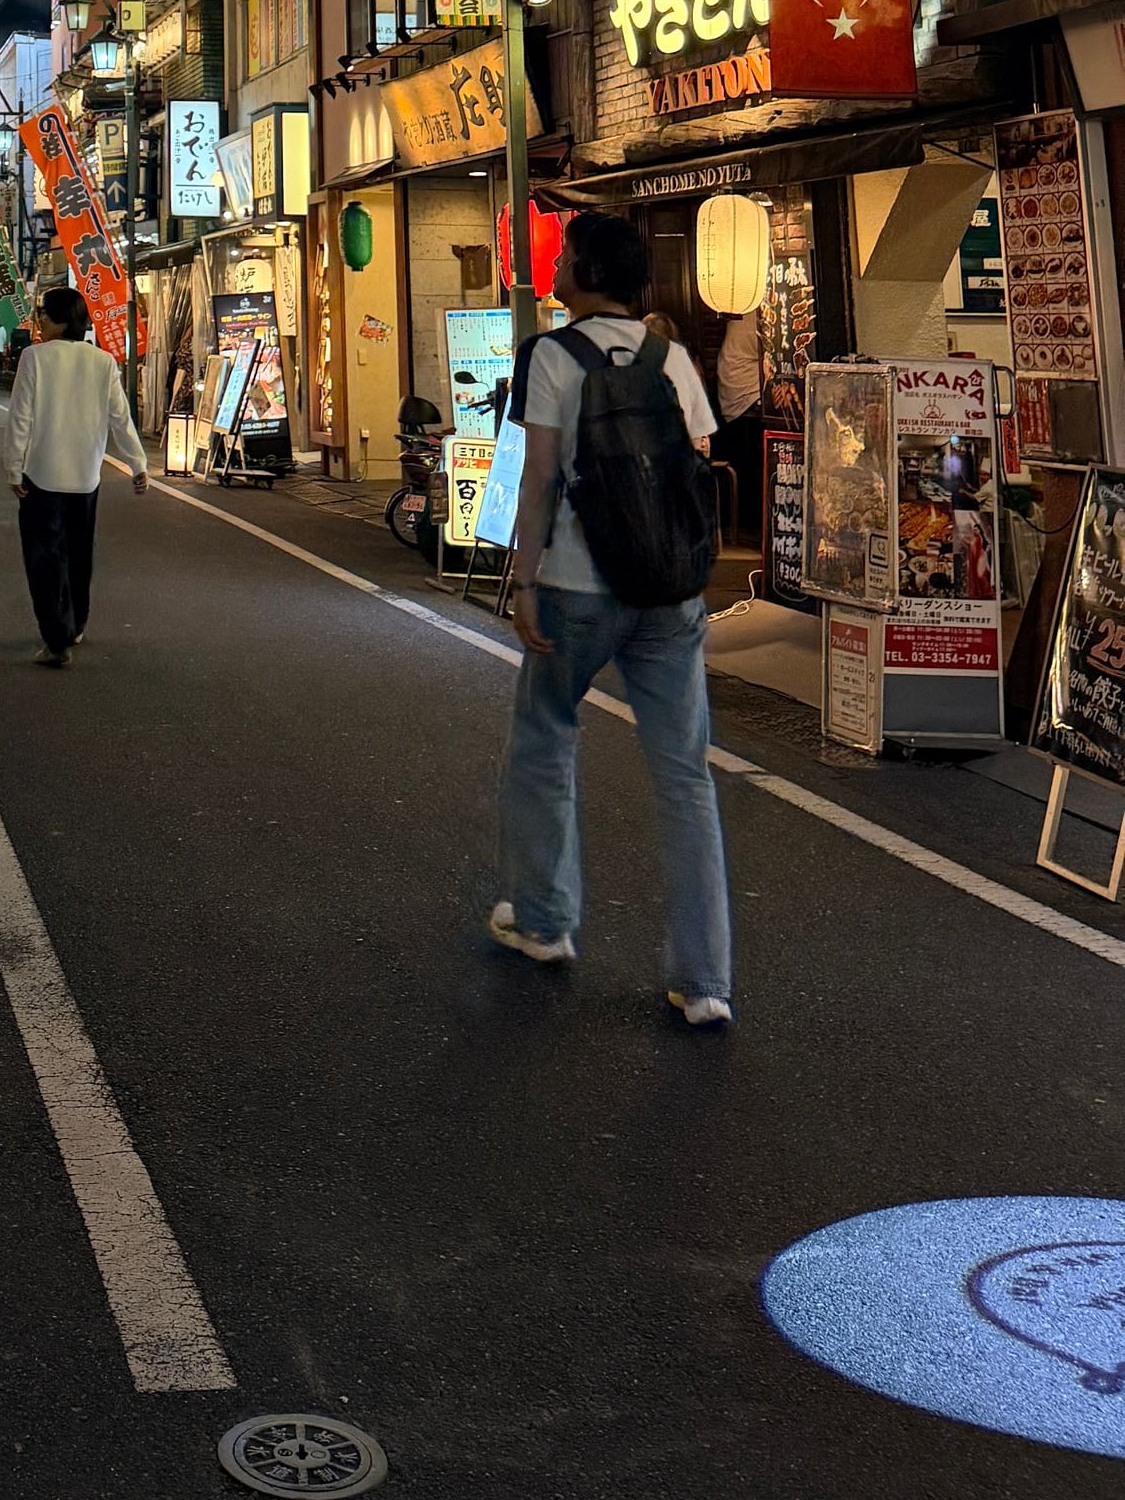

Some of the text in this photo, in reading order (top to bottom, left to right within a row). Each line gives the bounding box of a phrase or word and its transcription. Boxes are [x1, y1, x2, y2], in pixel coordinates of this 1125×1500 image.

[642, 49, 772, 117] YAKITON
[104, 122, 120, 146] P
[182, 110, 209, 182] おでん
[631, 161, 752, 198] SANCHOME NO YUTA
[178, 190, 213, 207] たけし
[896, 370, 985, 407] NKARA
[885, 651, 992, 665] TEL. 03-3354-7947
